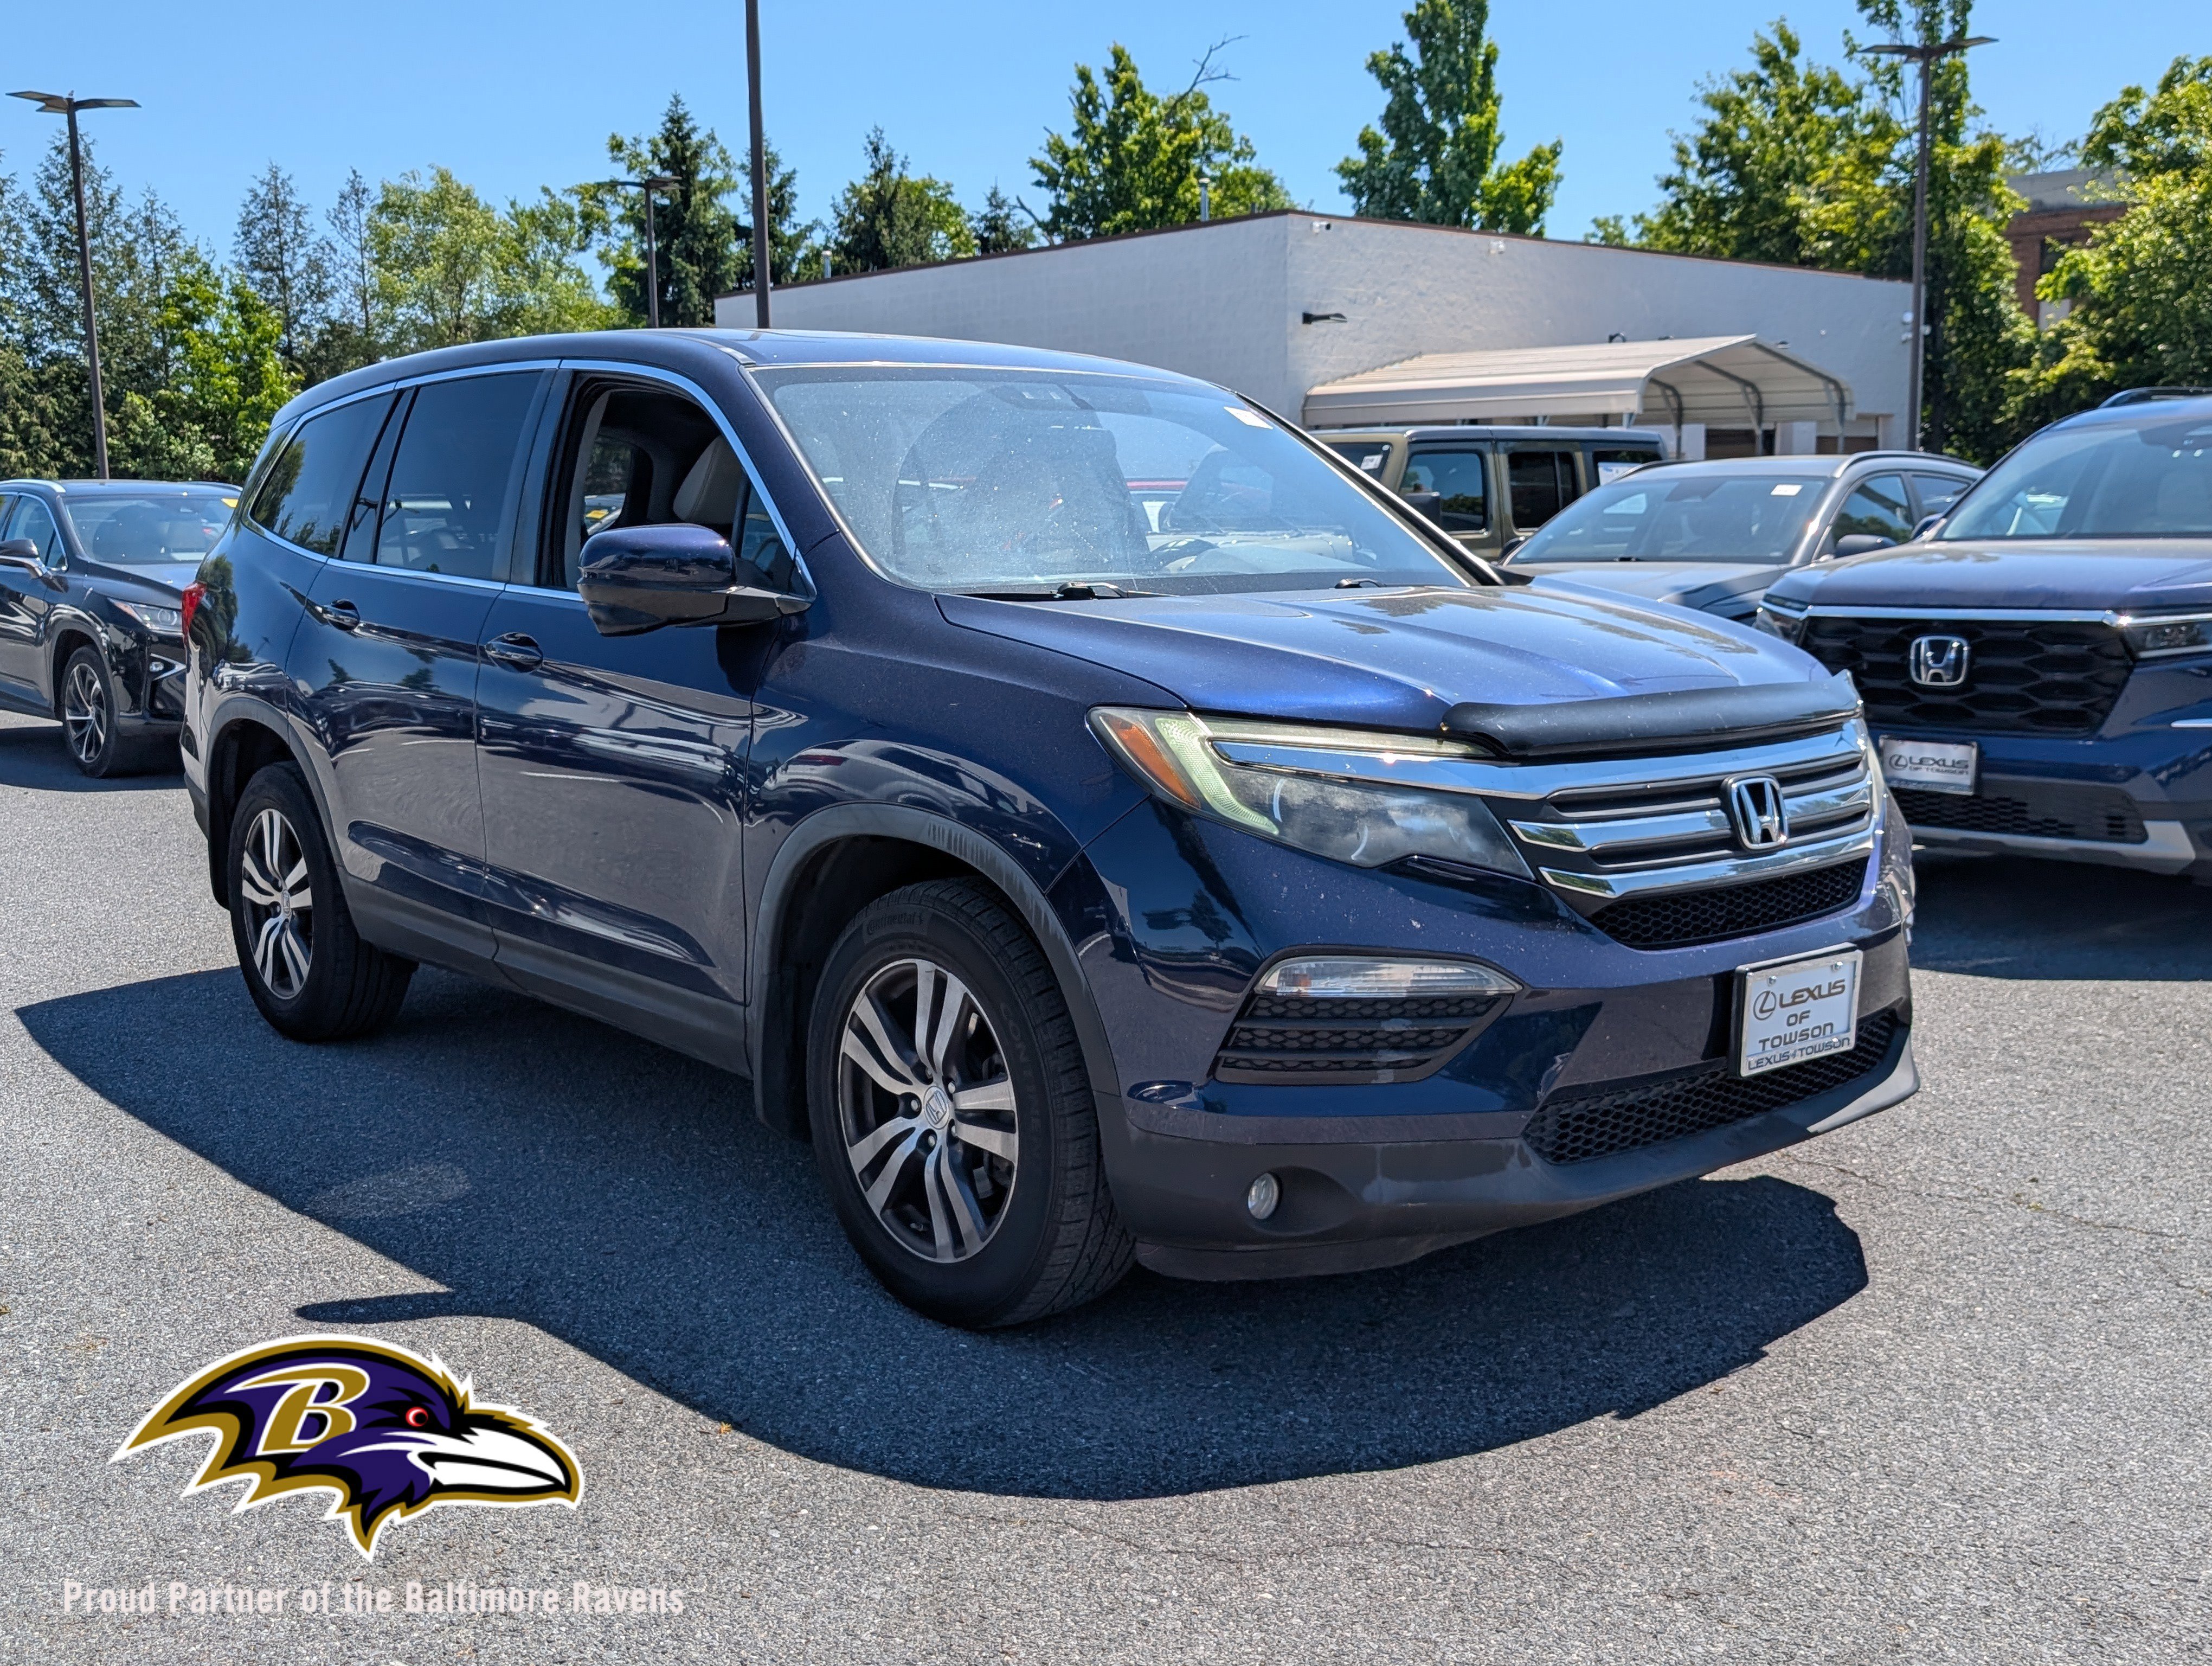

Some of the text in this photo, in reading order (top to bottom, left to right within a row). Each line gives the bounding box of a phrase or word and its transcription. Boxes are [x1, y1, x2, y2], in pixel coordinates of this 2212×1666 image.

[1909, 756, 1969, 769] LEXUS
[1779, 979, 1846, 1009] LEXUS
[1786, 1009, 1811, 1027] OF
[1758, 1022, 1834, 1051] TOWSON
[1748, 1050, 1790, 1071] LEXUS
[1797, 1037, 1850, 1058] TOWSON
